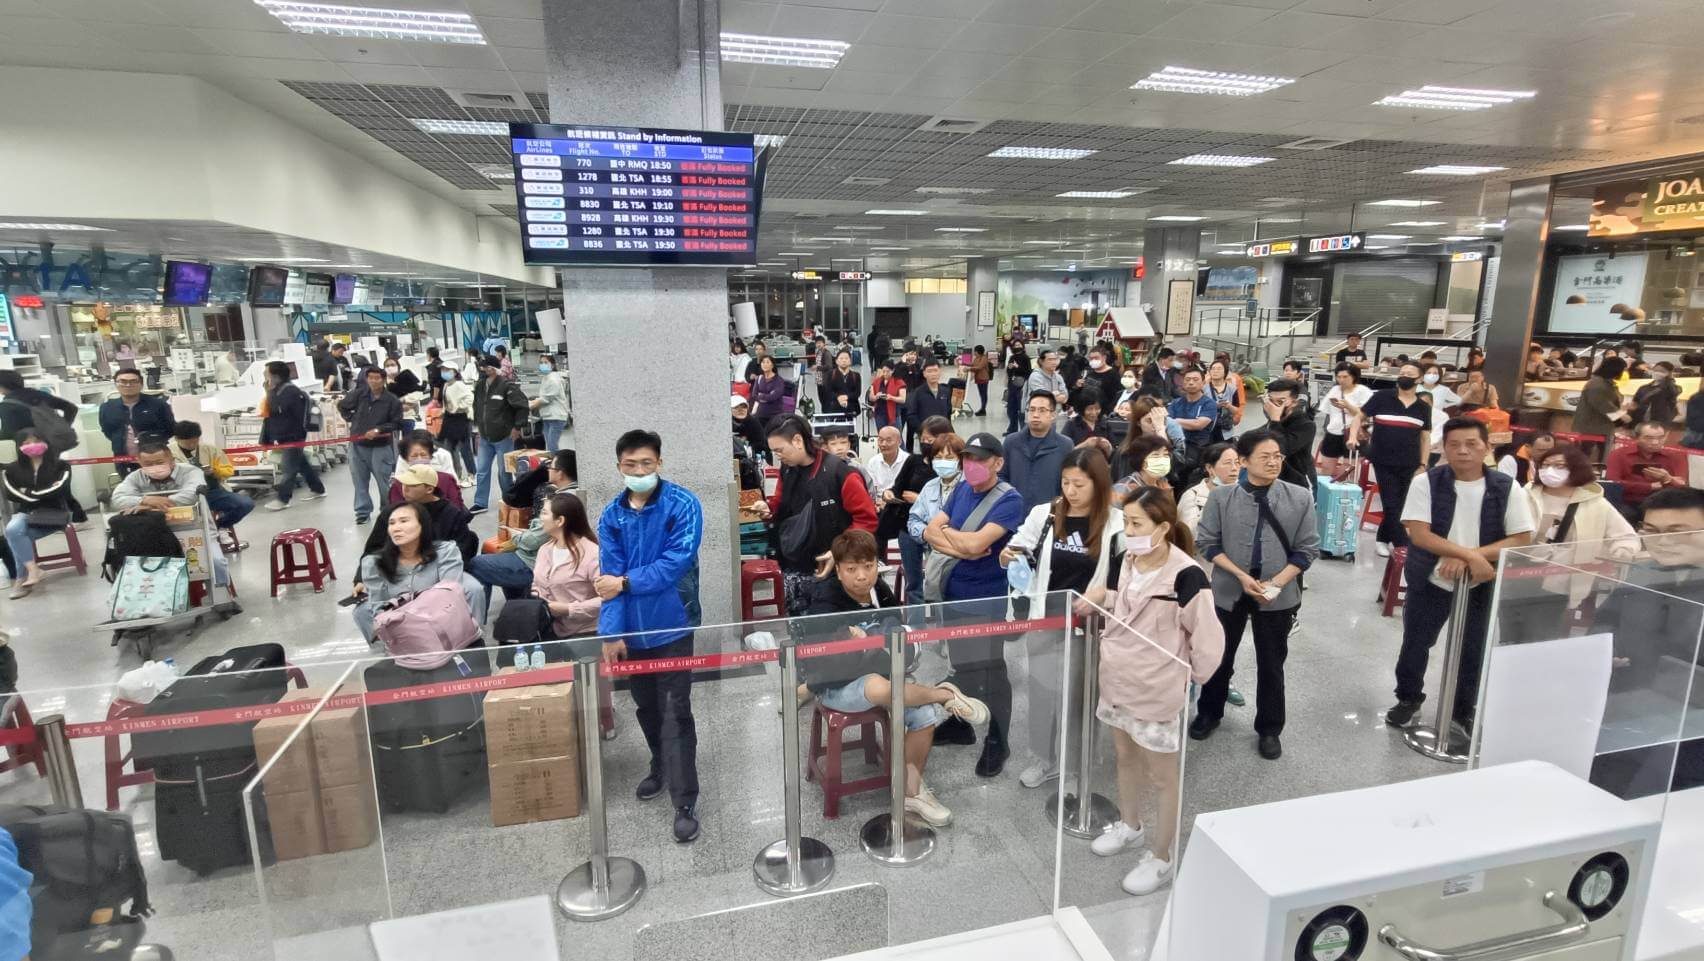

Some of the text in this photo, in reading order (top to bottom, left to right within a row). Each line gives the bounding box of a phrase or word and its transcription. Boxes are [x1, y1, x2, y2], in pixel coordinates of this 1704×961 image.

[618, 132, 641, 141] Stand
[643, 133, 653, 143] by
[655, 134, 702, 144] Information
[576, 159, 592, 167] 770
[628, 161, 648, 170] RMQ
[650, 161, 672, 170] 18:50
[697, 162, 716, 172] Fully
[718, 164, 746, 172] Booked
[577, 173, 598, 181] 1278
[628, 175, 645, 183] TSA
[651, 175, 672, 184] 18:55
[698, 176, 716, 186] Fully
[718, 177, 746, 185] Booked
[578, 186, 594, 195] 310
[629, 188, 647, 196] KHH
[652, 188, 673, 197] 19:00
[698, 189, 716, 199] Fully
[718, 190, 746, 199] Booked
[580, 200, 600, 209] 8830
[631, 201, 647, 210] TSA
[652, 202, 674, 211] 19:10
[699, 203, 717, 213] Fully
[718, 203, 747, 212] Booked
[581, 213, 601, 222] 8928
[631, 214, 649, 223] KHH
[653, 215, 675, 224] 19:30
[699, 216, 717, 226] Fully
[718, 216, 747, 225] Booked
[582, 227, 602, 236] 1280
[632, 228, 648, 236] TSA
[653, 228, 675, 237] 19:30
[700, 229, 717, 239] Fully
[718, 230, 747, 238] Booked
[583, 240, 603, 249] 8836
[633, 240, 649, 249] TSA
[654, 241, 676, 250] 19:50
[700, 242, 718, 252] Fully
[718, 242, 747, 251] Booked
[986, 625, 1007, 633] KINMEN
[1009, 622, 1032, 630] AIRPORT
[649, 661, 675, 670] KINMEN
[677, 658, 706, 667] AIRPORT
[442, 683, 471, 693] KINMEN
[474, 678, 507, 688] AIRPORT
[122, 720, 157, 731] KINMEN
[161, 716, 200, 729] AIRPORT
